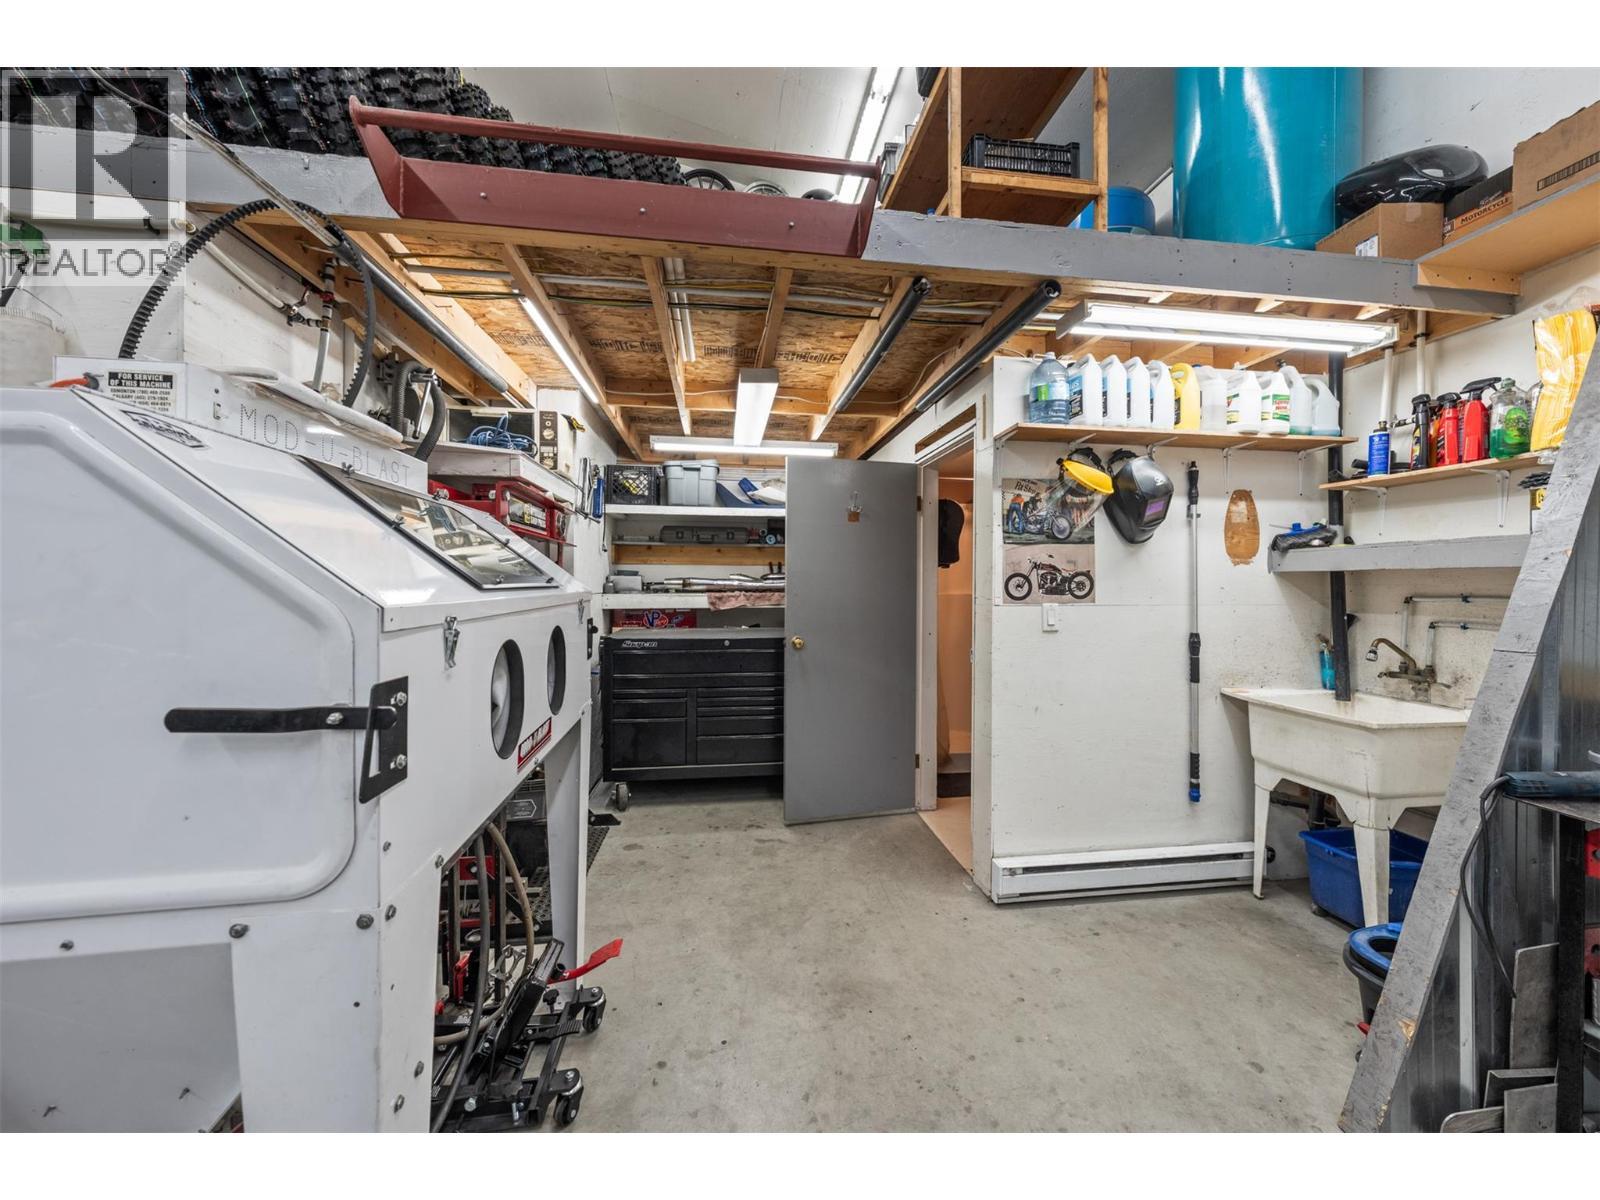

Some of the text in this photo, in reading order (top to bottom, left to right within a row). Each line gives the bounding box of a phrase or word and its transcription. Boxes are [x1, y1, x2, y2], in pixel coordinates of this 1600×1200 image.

[1460, 197, 1509, 225] MOTORCYCLE
[118, 372, 164, 381] FOR SERVICE
[139, 381, 171, 389] MACHINE
